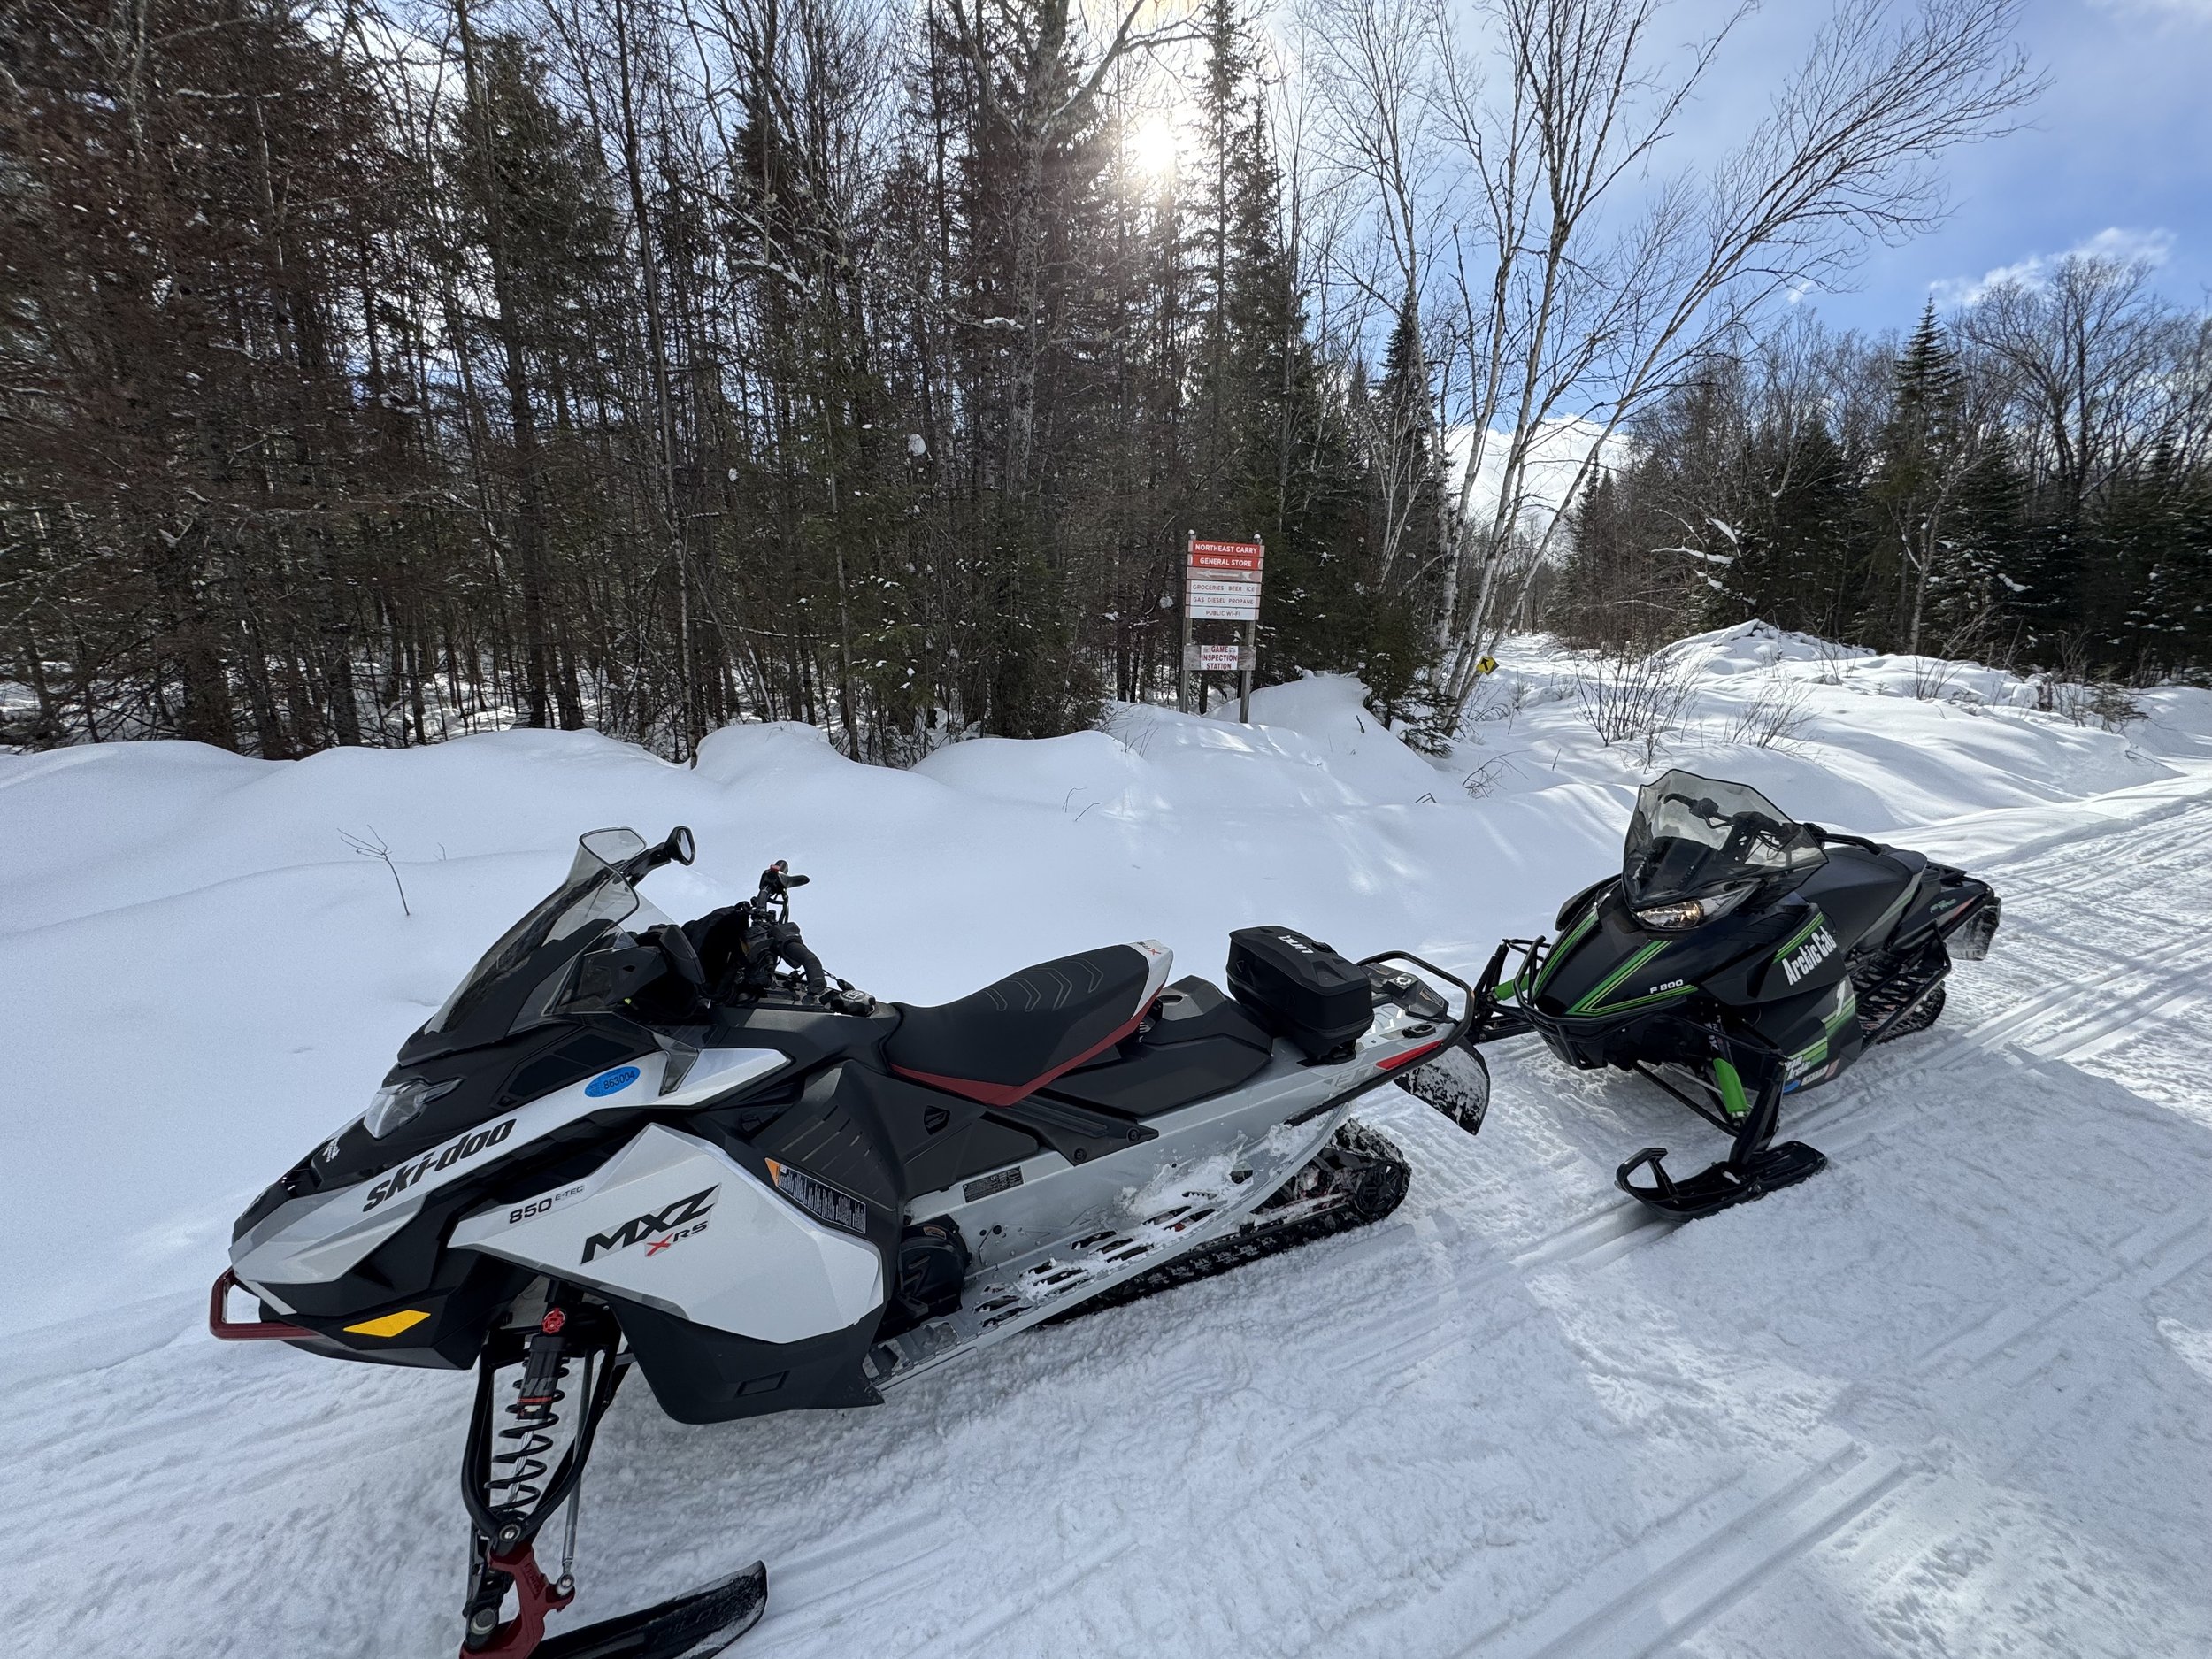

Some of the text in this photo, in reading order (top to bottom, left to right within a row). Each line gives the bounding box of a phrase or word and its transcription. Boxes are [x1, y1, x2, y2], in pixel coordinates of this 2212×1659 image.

[1194, 543, 1235, 553] NORTHEAST
[1781, 926, 1837, 987] Arctic Cat
[1649, 979, 1684, 995] F 800
[603, 1070, 635, 1090] 863004
[509, 1185, 585, 1225] 850 E-TEC
[580, 1182, 722, 1266] MXZ
